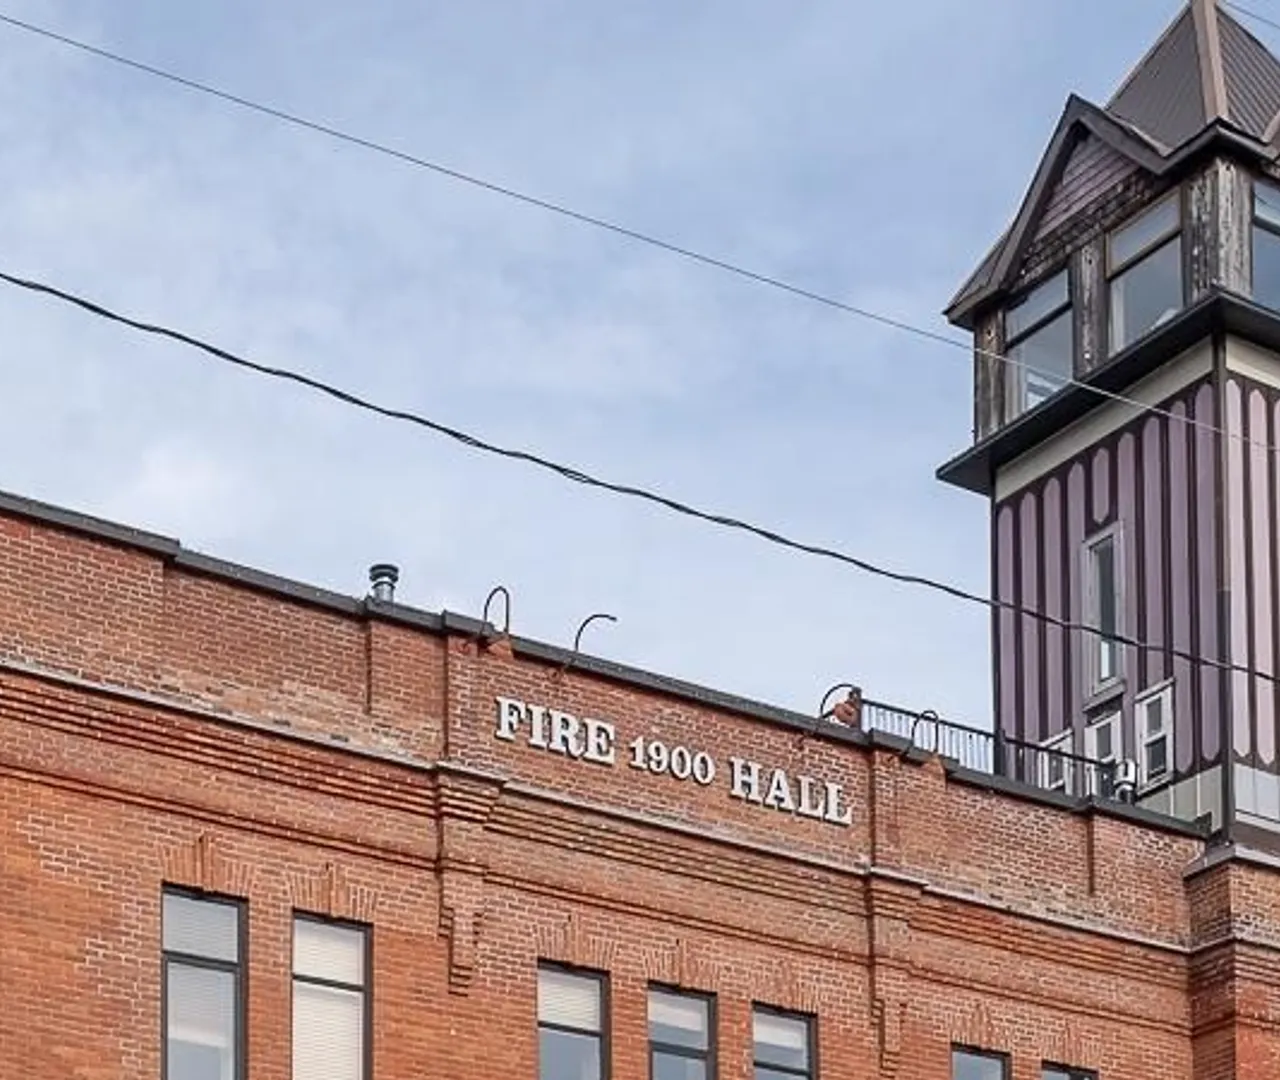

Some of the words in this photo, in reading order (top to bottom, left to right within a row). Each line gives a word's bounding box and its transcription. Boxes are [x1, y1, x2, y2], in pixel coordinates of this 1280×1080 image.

[494, 695, 615, 766] FIRE
[629, 735, 716, 786] 1900
[728, 757, 853, 825] HALL
